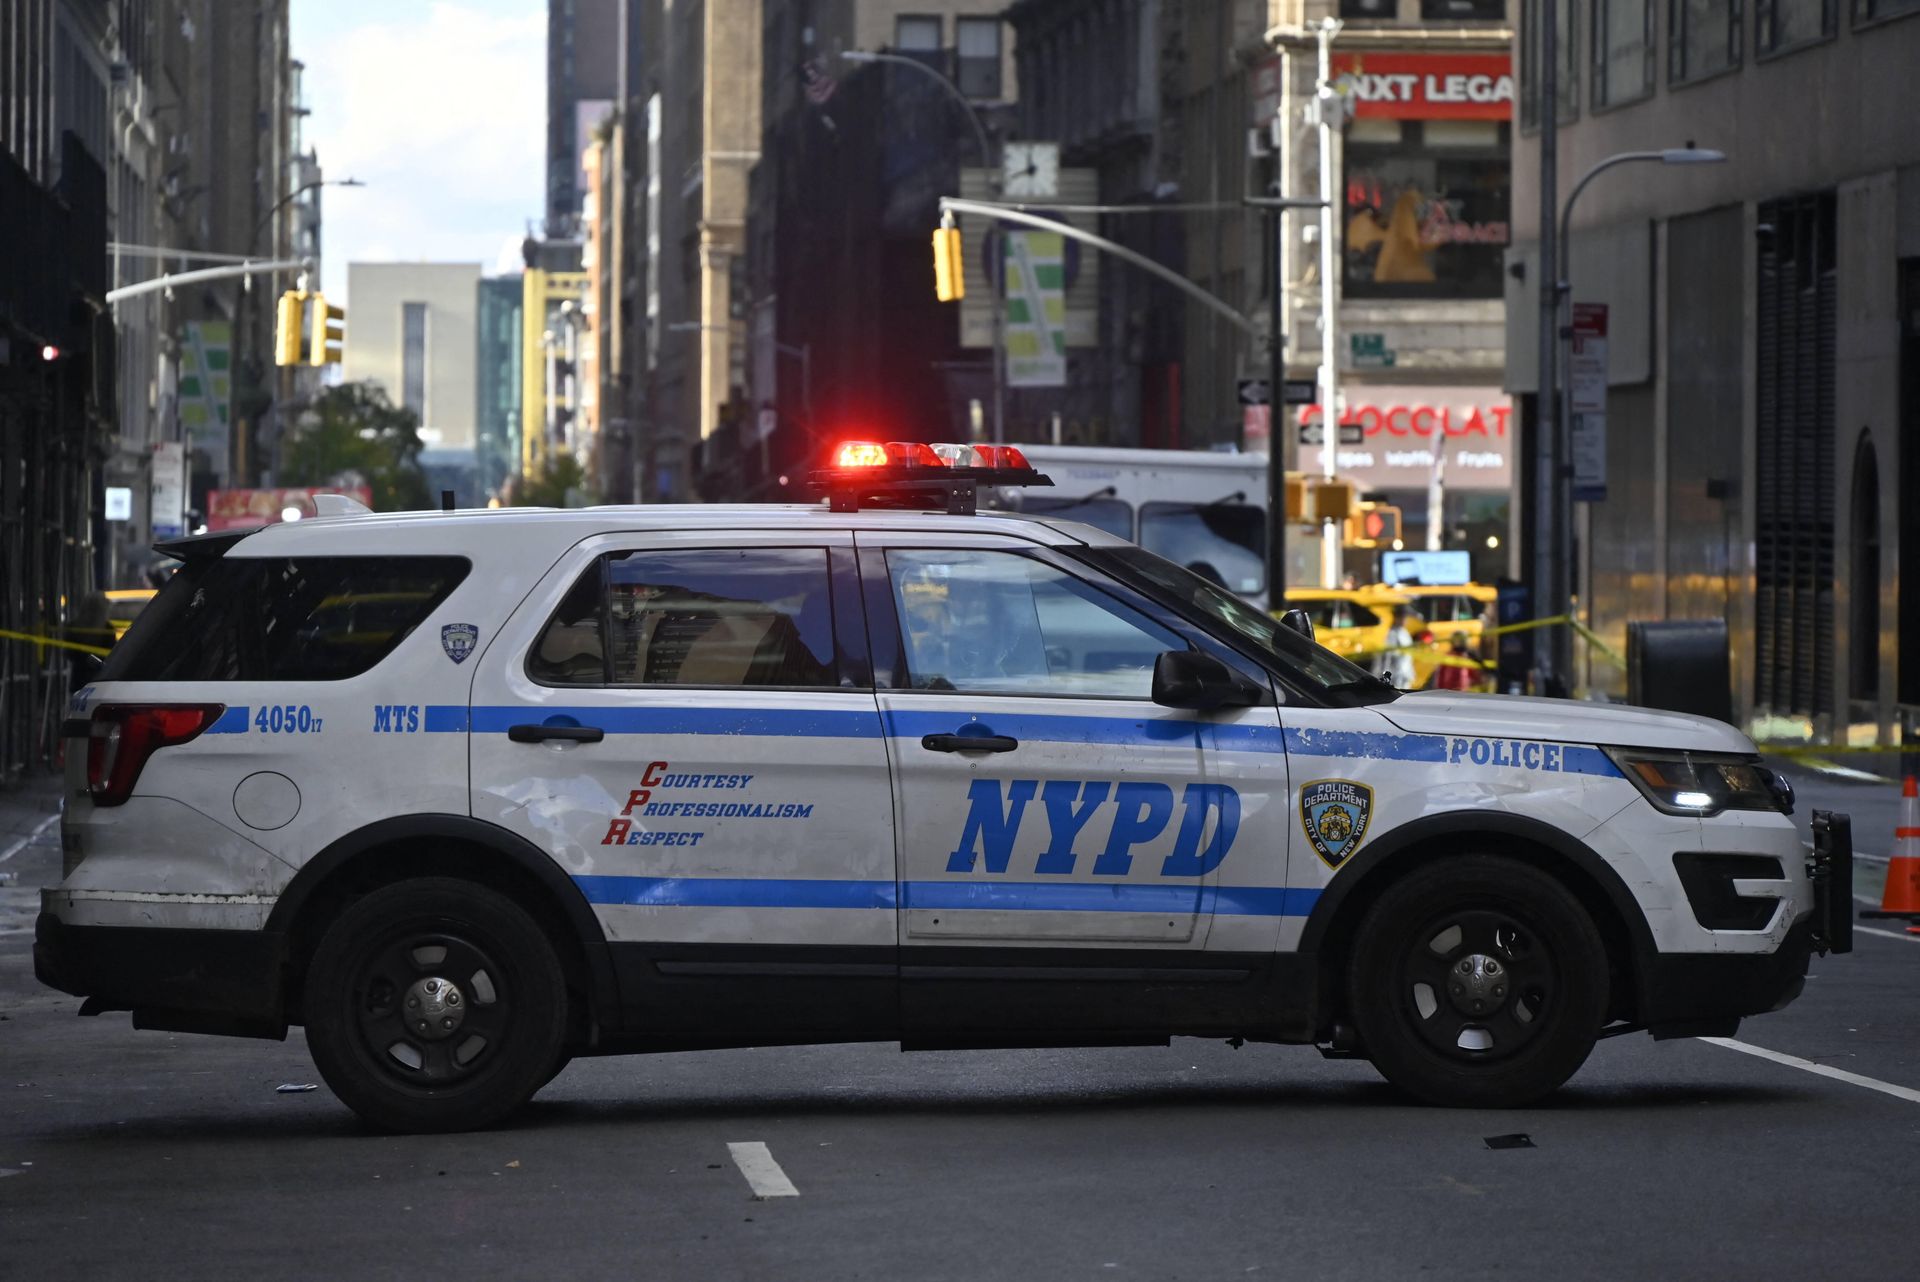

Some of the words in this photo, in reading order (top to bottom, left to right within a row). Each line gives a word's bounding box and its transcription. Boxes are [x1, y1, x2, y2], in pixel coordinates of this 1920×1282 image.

[374, 705, 419, 732] MTS
[1450, 738, 1559, 772] POLICE
[640, 761, 753, 789] COURTESY
[620, 789, 813, 818] PROFESSIONALISM
[1304, 793, 1368, 808] DEPARTMENT
[1318, 784, 1355, 795] POLICE
[601, 818, 704, 846] RESPECT
[945, 779, 1241, 876] NYPD
[1305, 818, 1318, 839] CITY
[1316, 842, 1327, 853] OF
[1340, 839, 1356, 858] NEW
[1354, 814, 1367, 836] YORK
